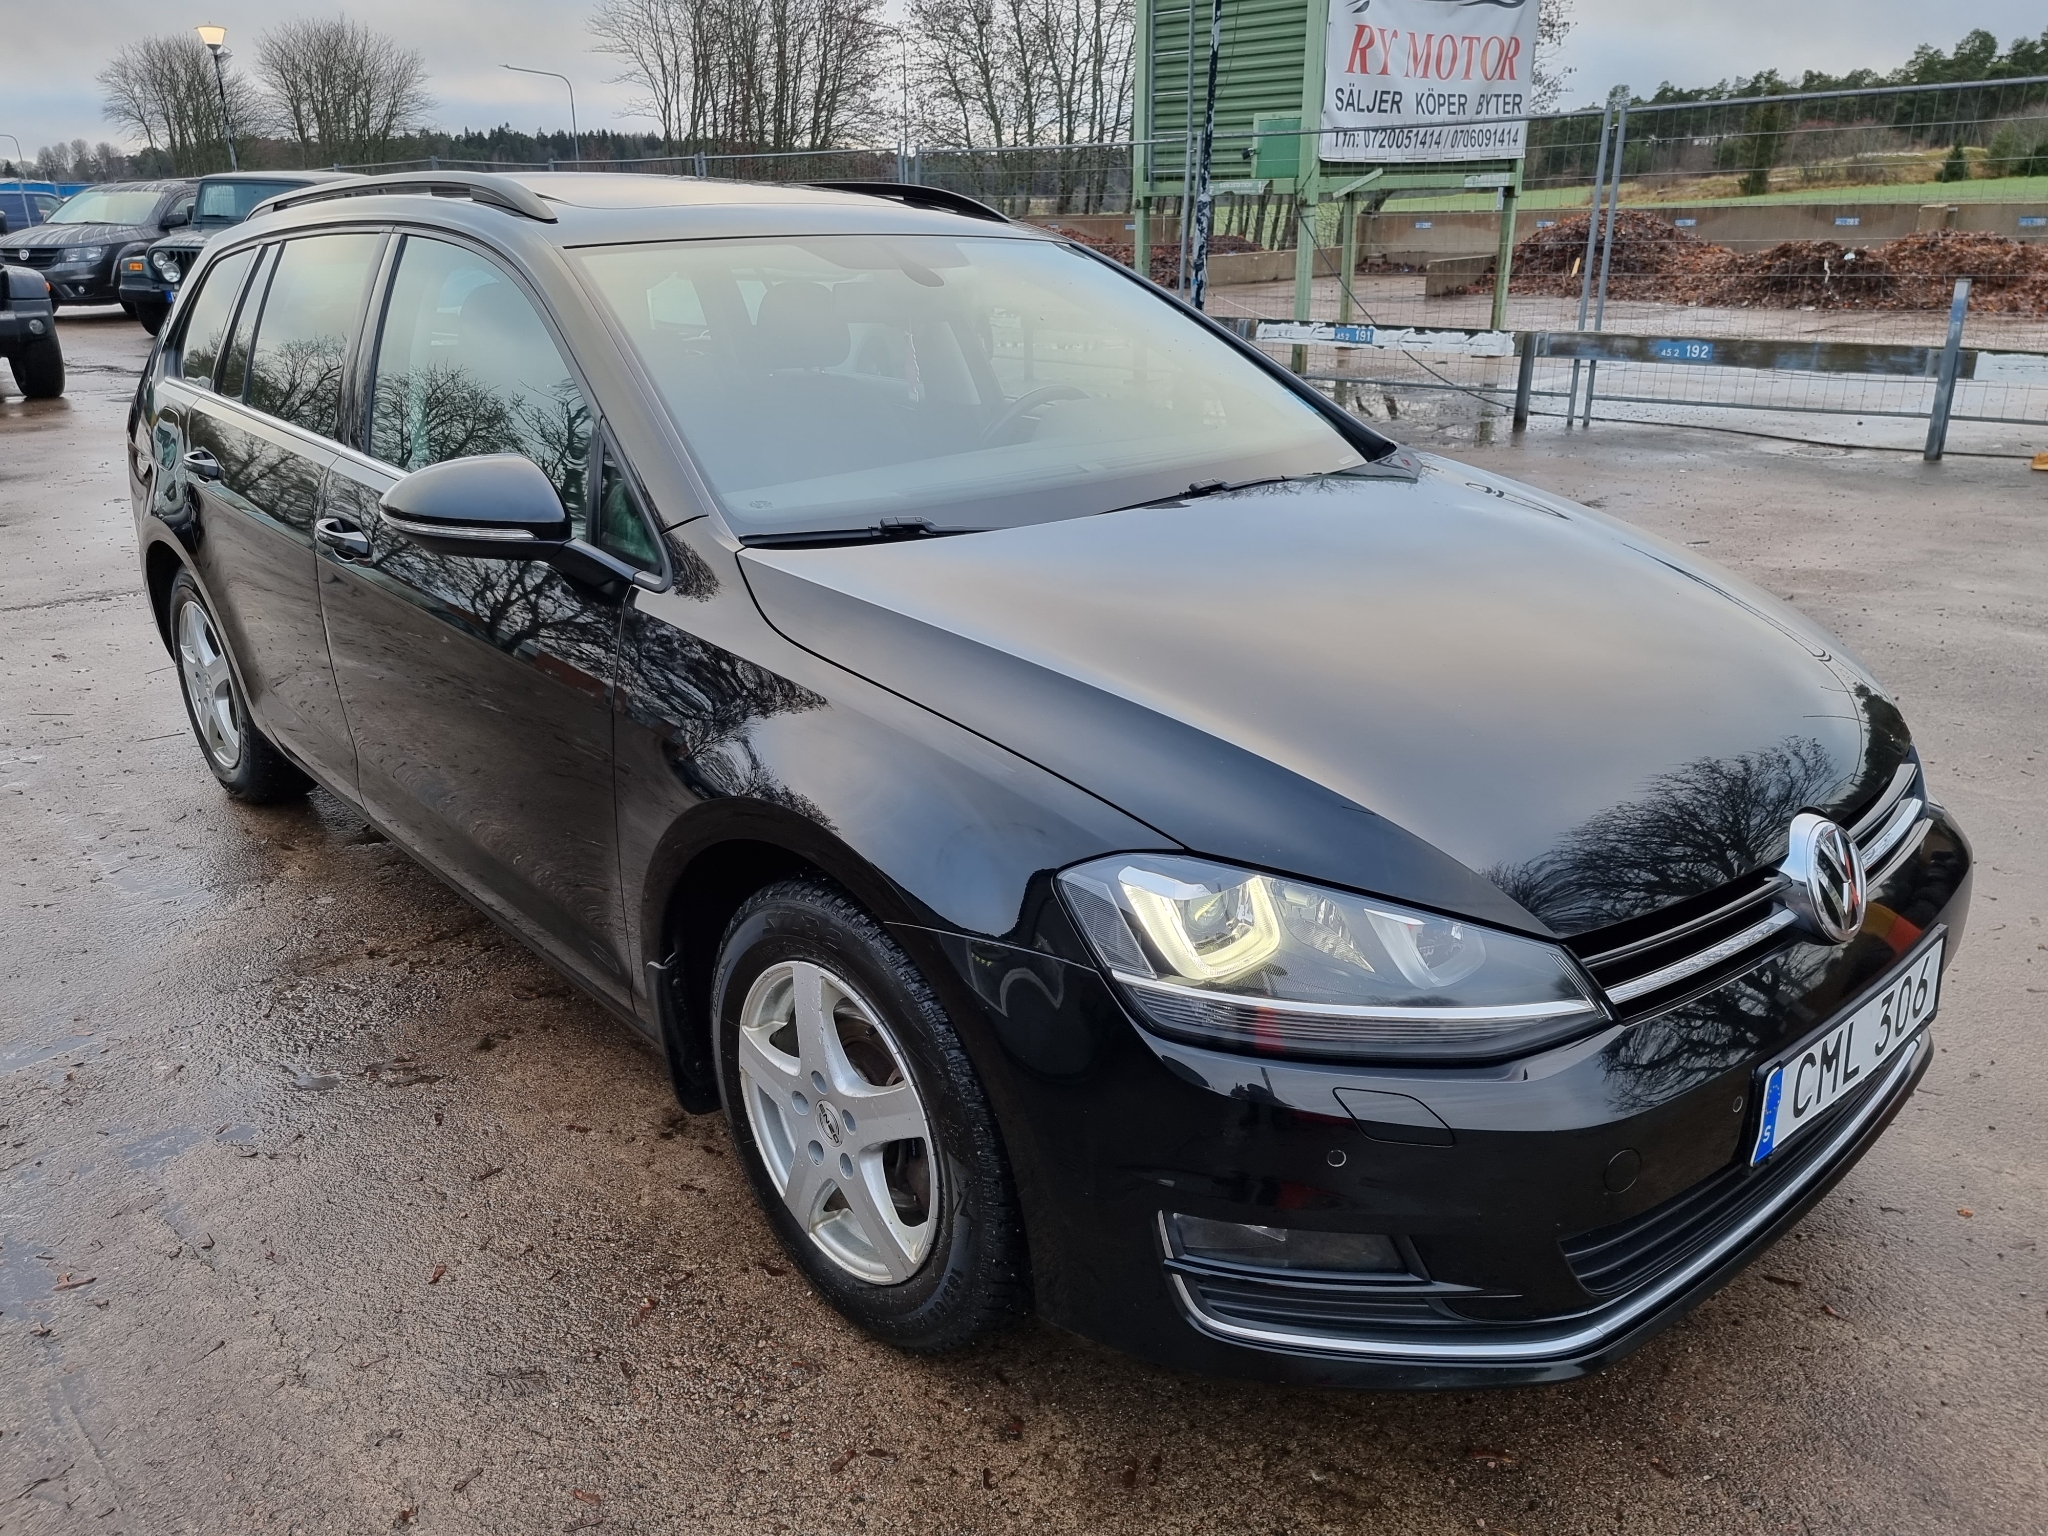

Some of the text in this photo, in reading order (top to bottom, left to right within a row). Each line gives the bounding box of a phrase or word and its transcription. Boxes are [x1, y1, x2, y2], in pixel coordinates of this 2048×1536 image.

[1345, 24, 1521, 82] RY MOTOR
[1335, 83, 1523, 116] SÄLJER KÖPER BYTER
[1355, 330, 1371, 341] 191
[1686, 344, 1709, 358] 192
[1793, 956, 1930, 1118] CML 306
[1762, 1125, 1772, 1142] S
